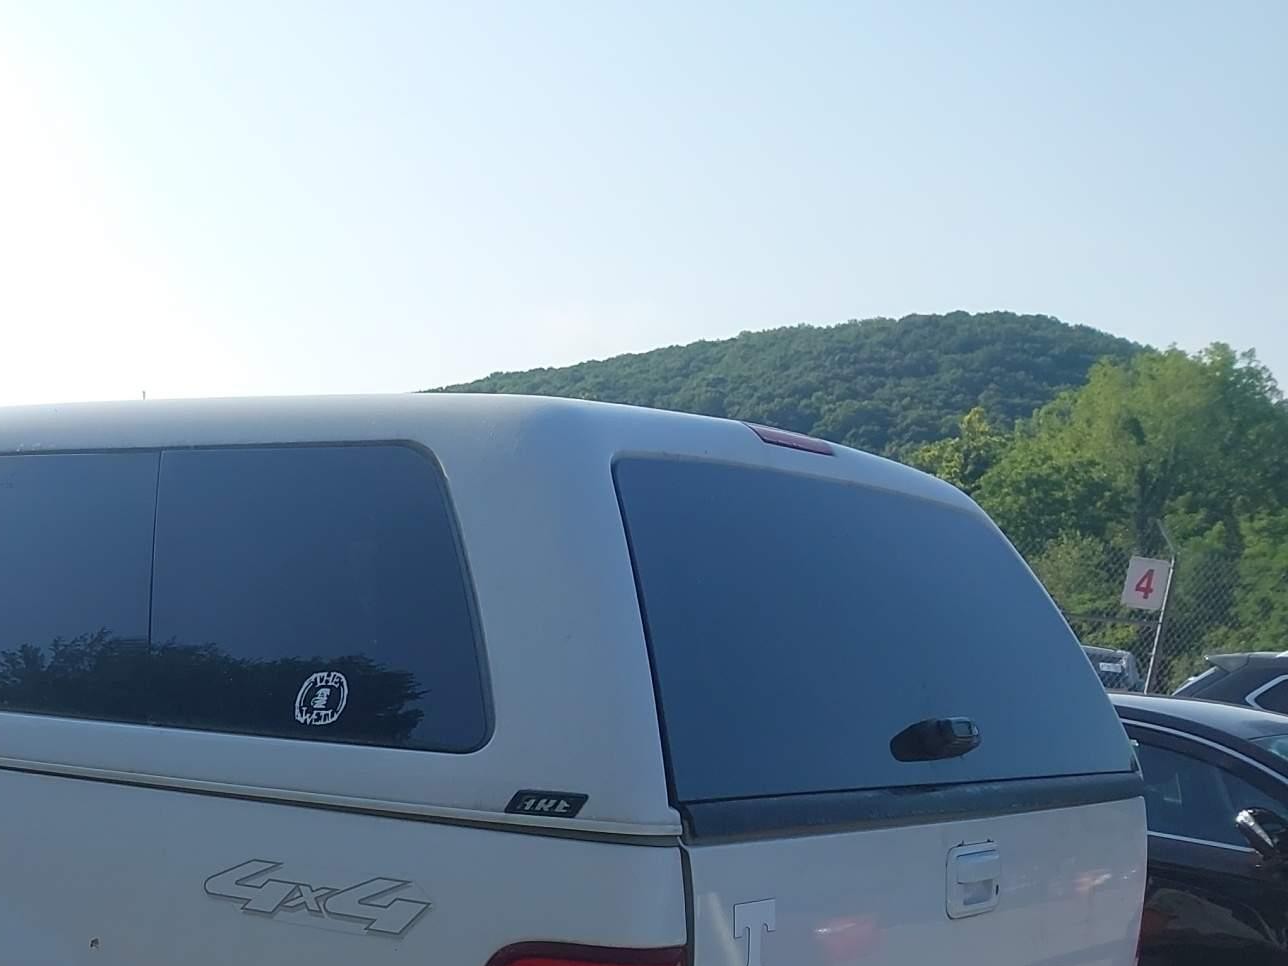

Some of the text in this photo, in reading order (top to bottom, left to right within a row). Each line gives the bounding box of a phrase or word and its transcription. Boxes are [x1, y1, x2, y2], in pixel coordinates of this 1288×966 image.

[1135, 568, 1155, 600] 4
[313, 671, 342, 689] THE
[203, 858, 432, 936] 4x4
